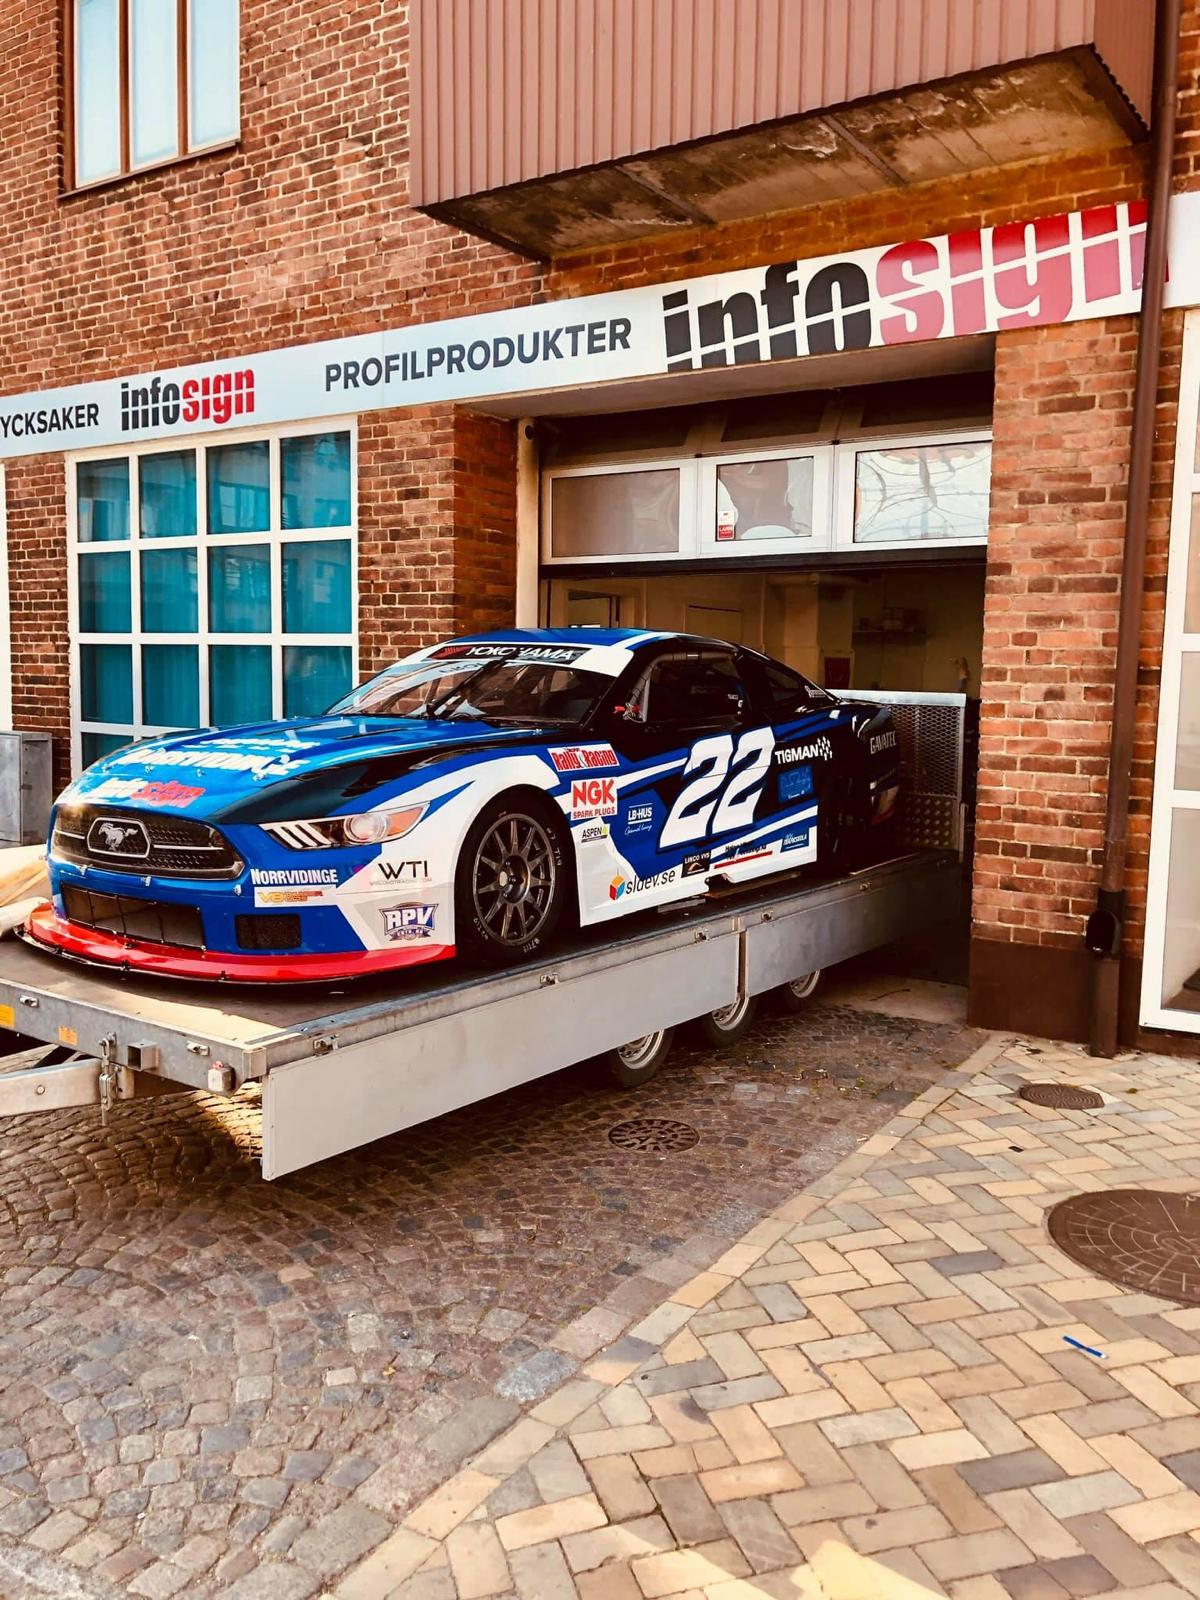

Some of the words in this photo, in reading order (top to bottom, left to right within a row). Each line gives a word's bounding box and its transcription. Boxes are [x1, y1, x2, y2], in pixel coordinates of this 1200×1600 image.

[325, 317, 632, 392] PROFILPRODUKTER
[121, 368, 255, 432] infosign
[0, 403, 99, 438] YCKSAKER
[466, 646, 574, 660] YOKOYAMA
[775, 744, 819, 765] TIGMAN
[572, 778, 616, 808] NGK
[660, 726, 776, 848] 22
[573, 810, 593, 819] SPARK
[594, 807, 616, 816] PLUGS
[628, 807, 652, 821] LB-HUS
[582, 827, 602, 839] ASPEN
[250, 868, 338, 885] NORRVIDINGE
[378, 860, 428, 880] WTI
